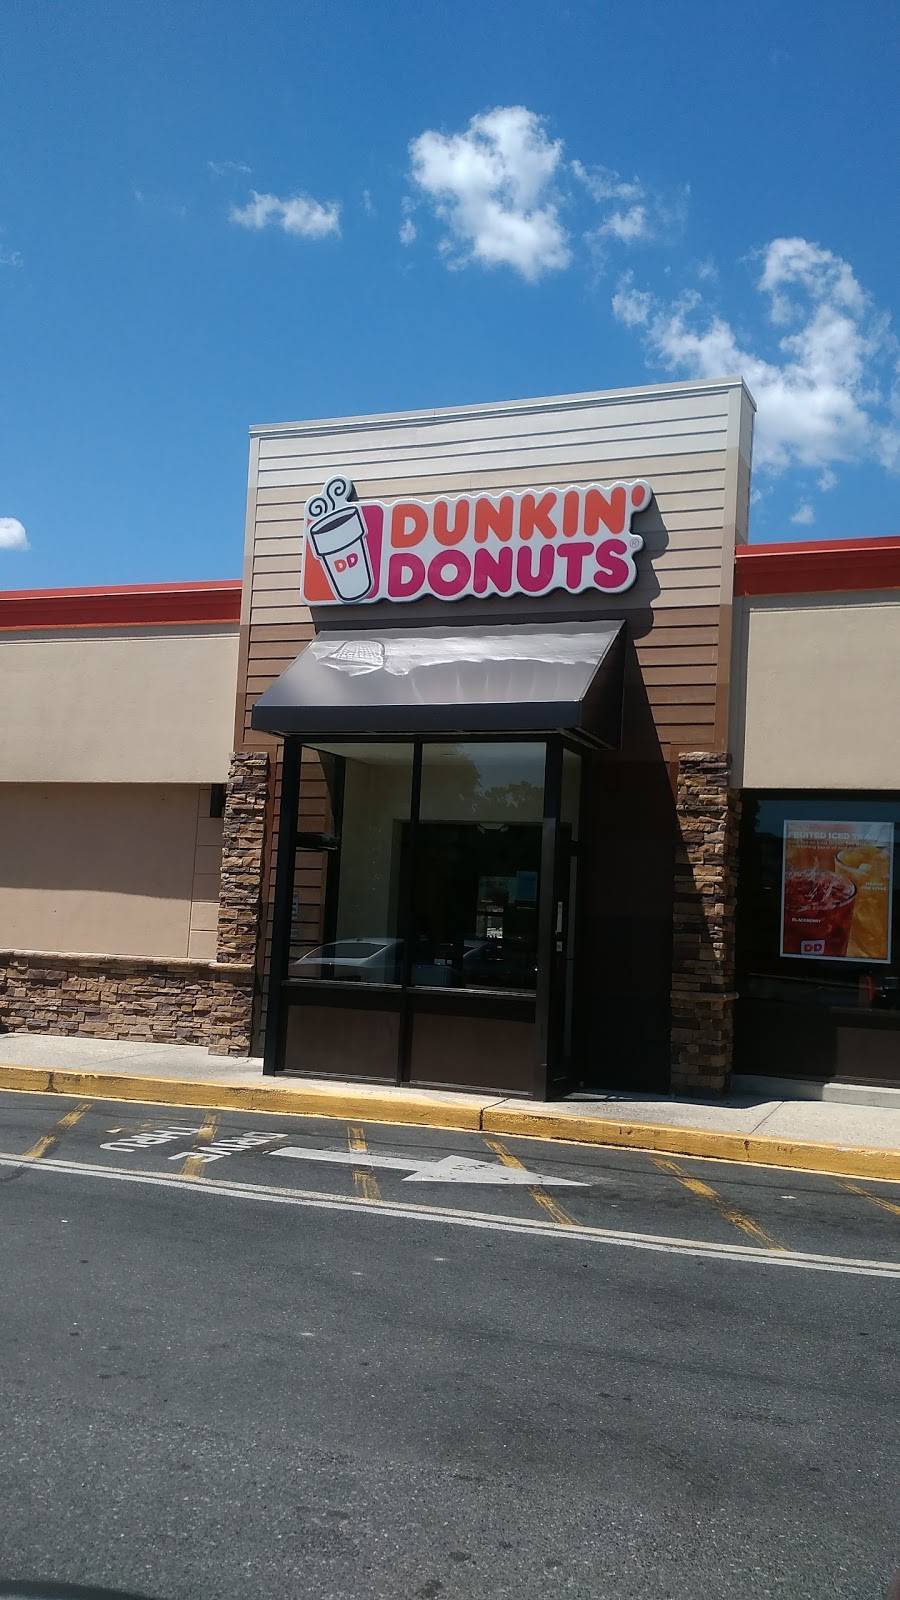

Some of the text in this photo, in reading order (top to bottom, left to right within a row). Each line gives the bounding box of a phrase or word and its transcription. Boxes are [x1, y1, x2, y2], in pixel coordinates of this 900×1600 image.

[390, 485, 646, 548] DUNKIN'
[334, 552, 358, 573] DD
[387, 538, 630, 598] DONUTS
[804, 943, 822, 952] DD
[99, 1126, 199, 1152] THRU
[167, 1131, 288, 1163] DRIVE
